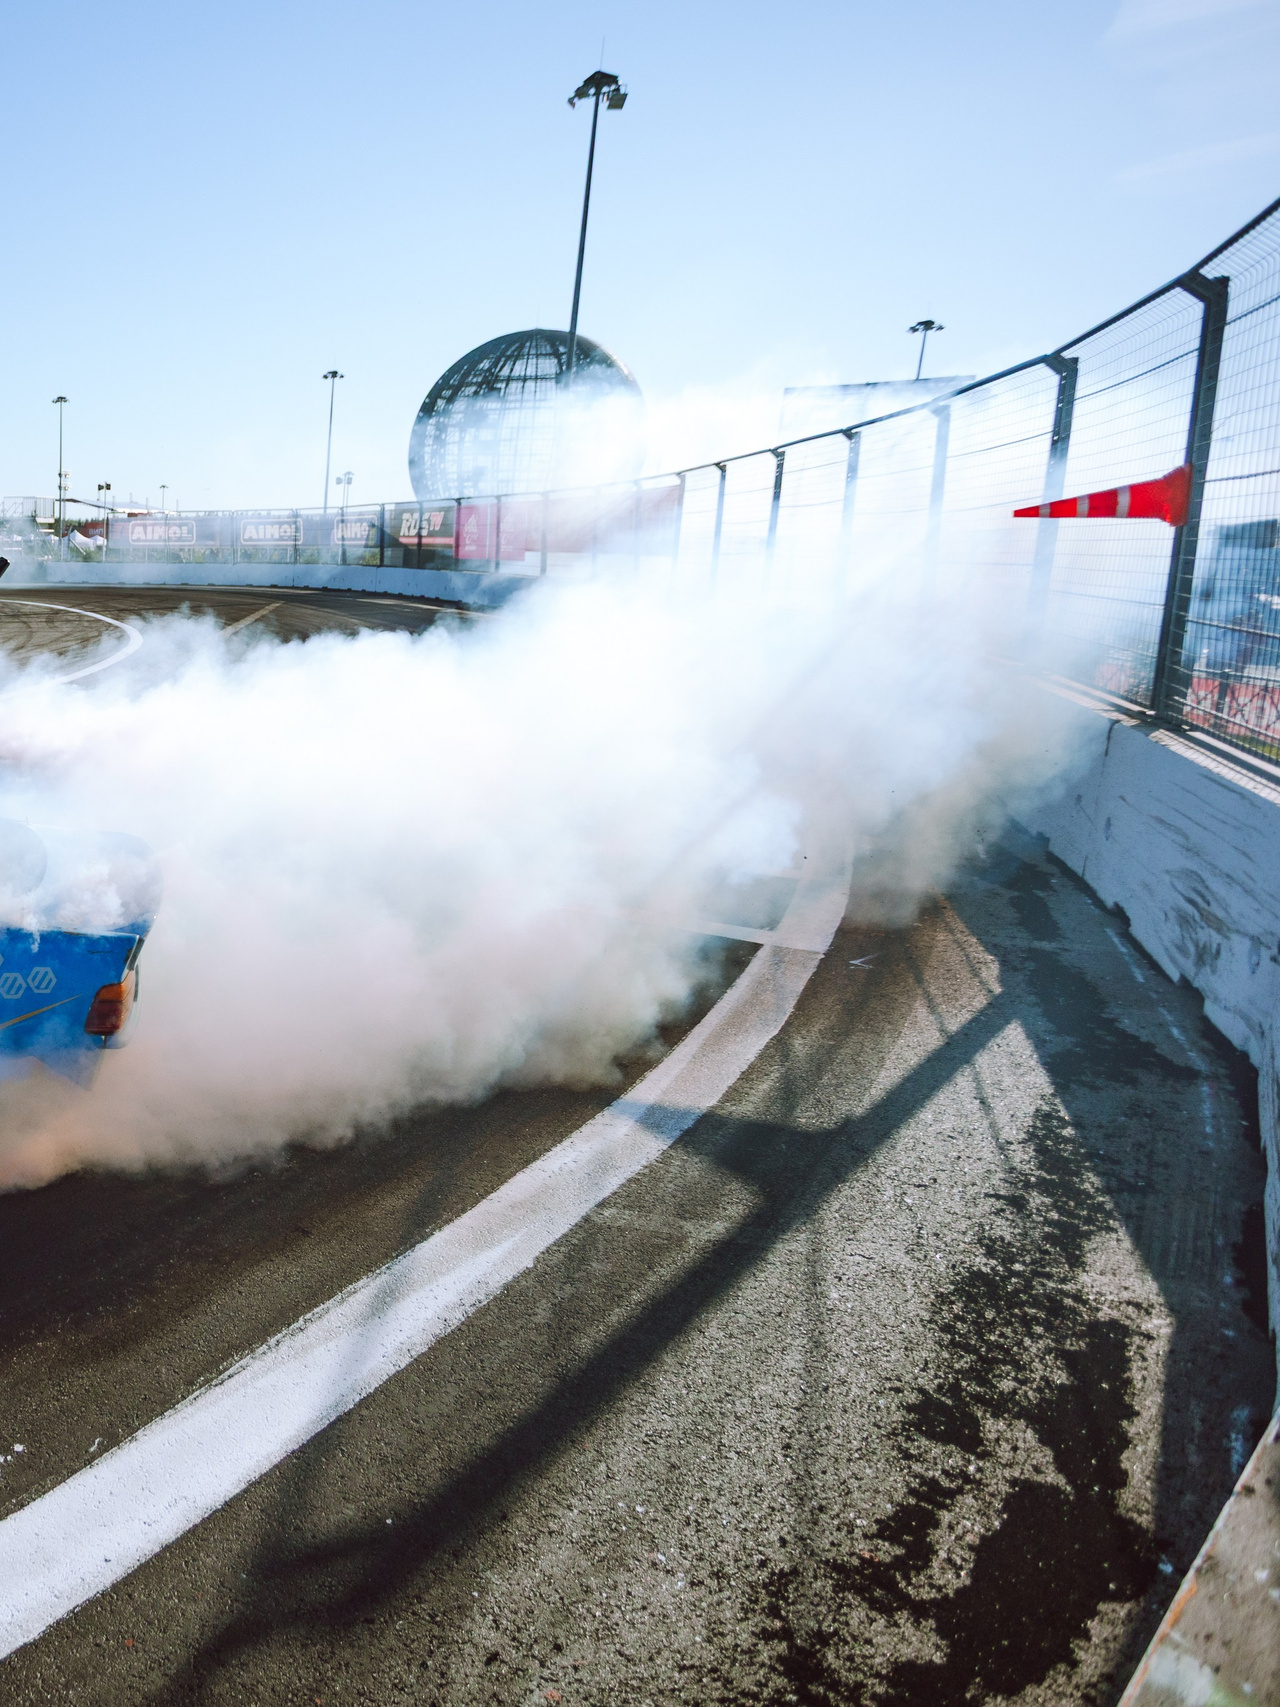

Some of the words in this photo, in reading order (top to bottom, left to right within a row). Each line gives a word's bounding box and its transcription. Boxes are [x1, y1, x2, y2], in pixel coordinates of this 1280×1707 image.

[131, 526, 193, 540] AIMOL
[244, 524, 301, 540] AIMOL
[337, 522, 370, 538] AIMO
